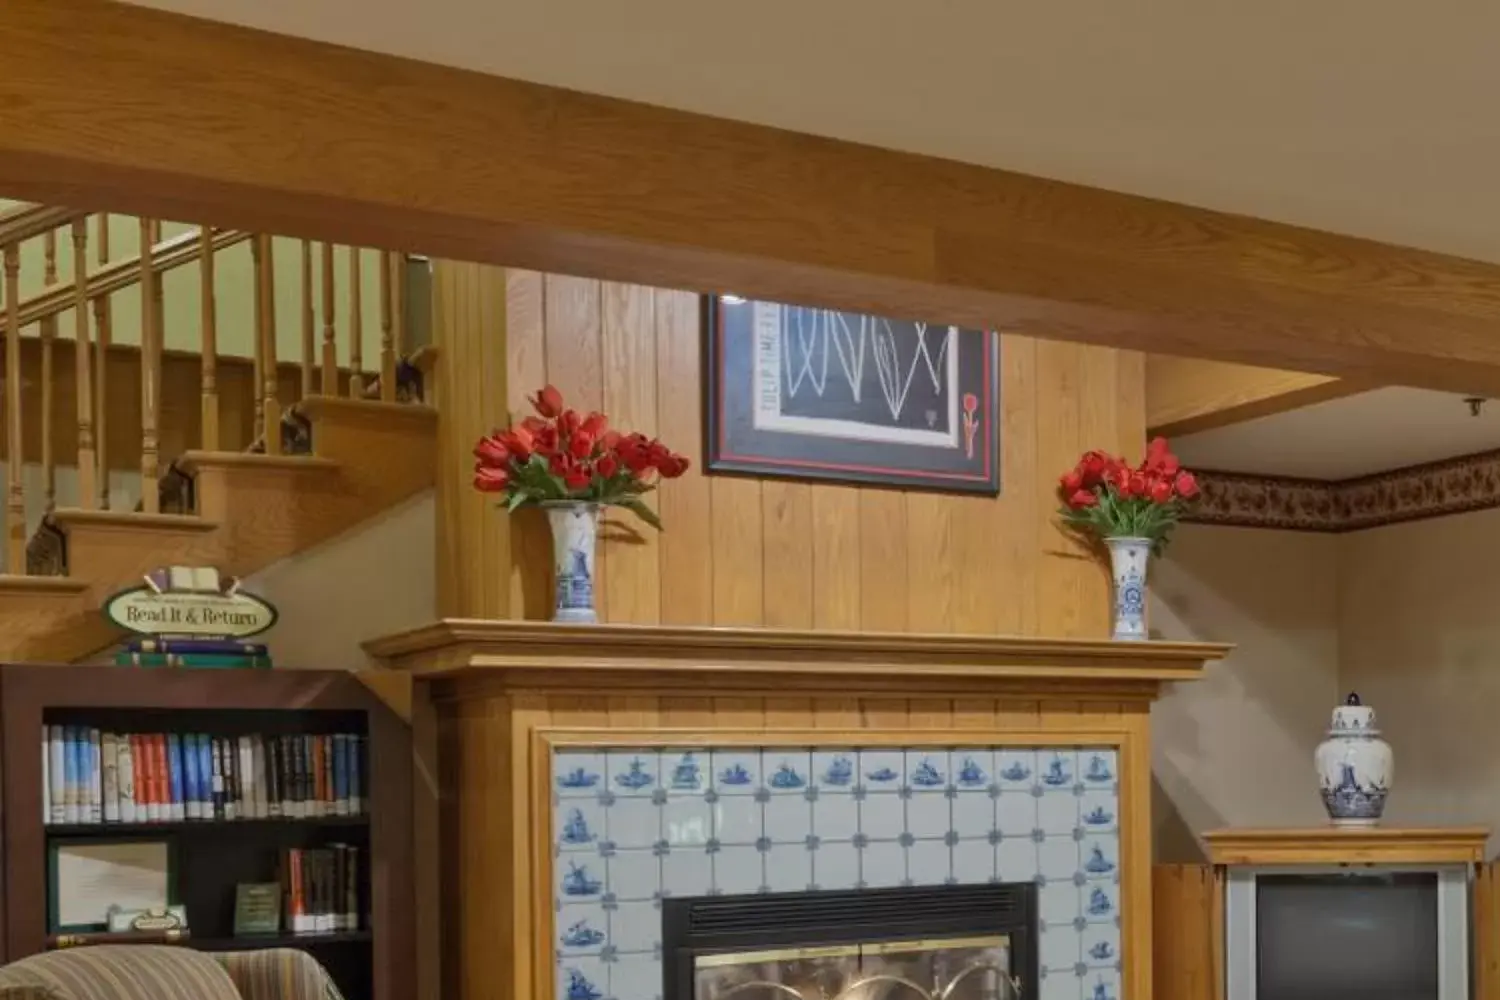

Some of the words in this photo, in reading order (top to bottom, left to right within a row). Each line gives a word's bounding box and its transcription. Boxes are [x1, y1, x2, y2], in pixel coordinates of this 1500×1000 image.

[126, 606, 166, 623] Read
[169, 607, 183, 623] It
[185, 608, 198, 625] &
[203, 607, 258, 626] Return
